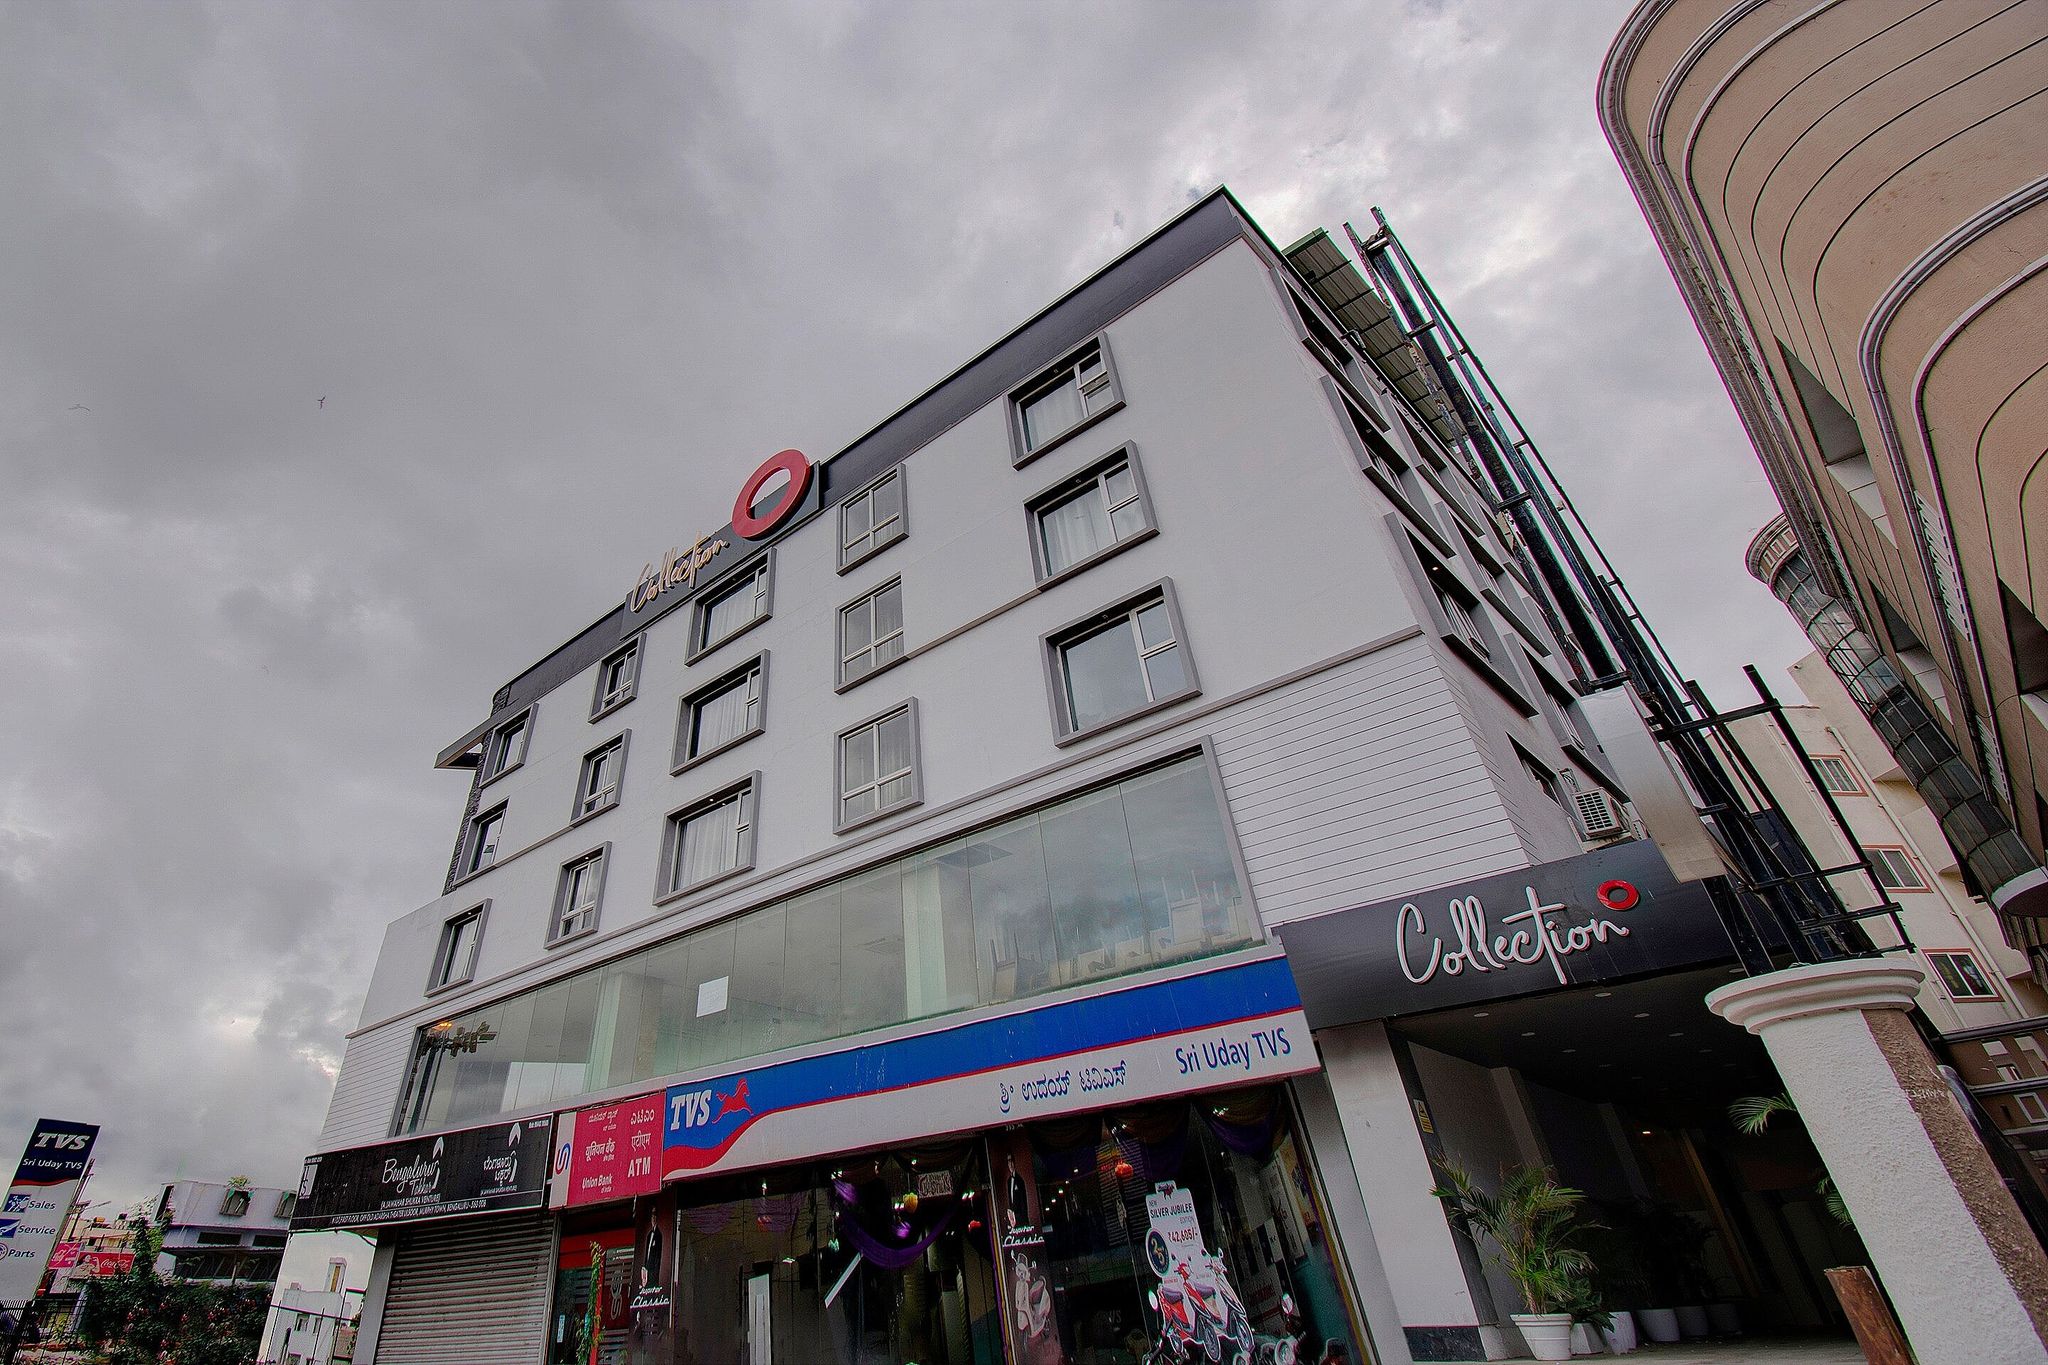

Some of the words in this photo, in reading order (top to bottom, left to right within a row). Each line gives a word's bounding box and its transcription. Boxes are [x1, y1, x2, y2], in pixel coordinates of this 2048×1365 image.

[631, 531, 730, 613] Collection
[1397, 886, 1630, 985] Collection
[1175, 1044, 1200, 1074] Sri
[1202, 1037, 1250, 1070] Uday
[1251, 1027, 1291, 1058] TVS
[1022, 1070, 1071, 1101] ಉದಯ್
[670, 1089, 712, 1131] TVS
[34, 1132, 90, 1150] TVS
[631, 1130, 651, 1151] एटीएम
[22, 1158, 36, 1166] Sri
[38, 1160, 62, 1169] Uday
[65, 1161, 83, 1169] TVS
[628, 1156, 651, 1177] ATM
[382, 1154, 439, 1194] Bengaluru
[582, 1177, 598, 1190] Union
[598, 1173, 612, 1187] Bank
[28, 1200, 56, 1210] Sales
[1150, 1207, 1169, 1219] SILVER
[1169, 1203, 1193, 1216] JUBILEE
[18, 1225, 56, 1235] Service
[1002, 1234, 1045, 1247] Classic
[8, 1249, 35, 1258] Parts
[630, 1295, 669, 1308] Classic
